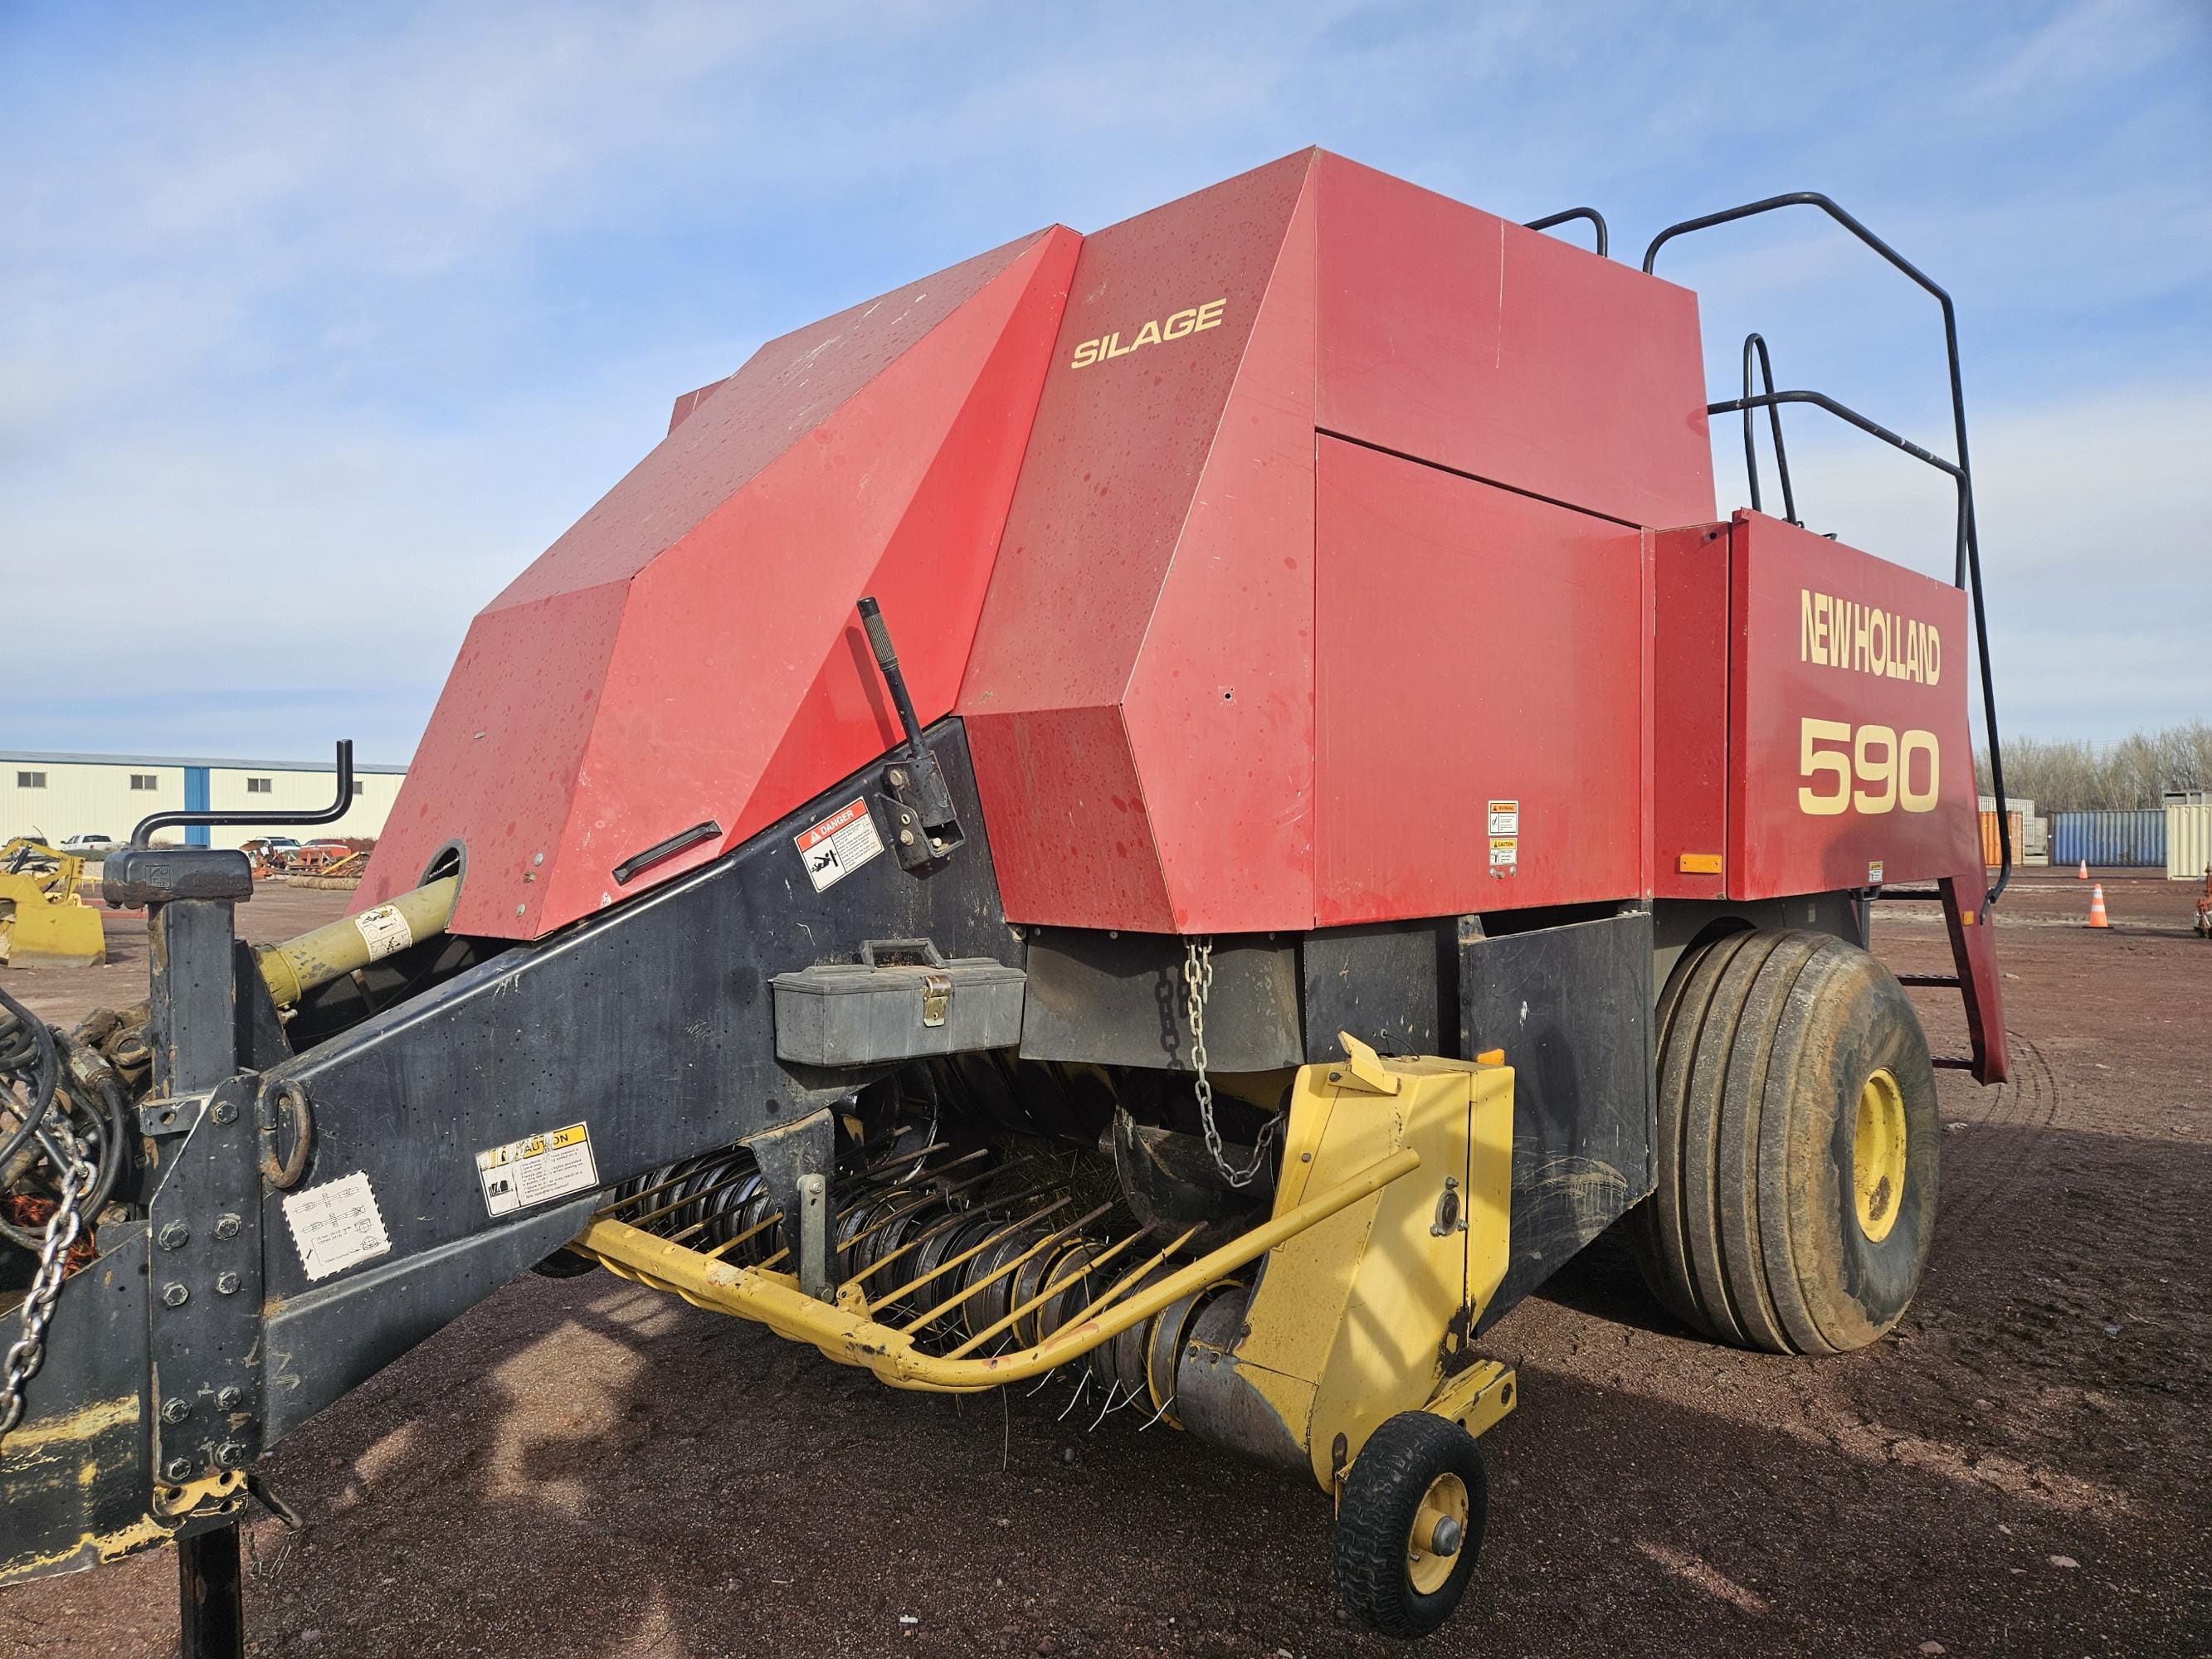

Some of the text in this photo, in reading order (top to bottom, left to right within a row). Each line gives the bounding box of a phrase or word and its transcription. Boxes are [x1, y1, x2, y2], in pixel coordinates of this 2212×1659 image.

[1071, 298, 1227, 369] SILAGE
[1801, 589, 1941, 686] NEW HOLLAND
[1799, 717, 1940, 815] 590
[820, 810, 854, 835] DANGER
